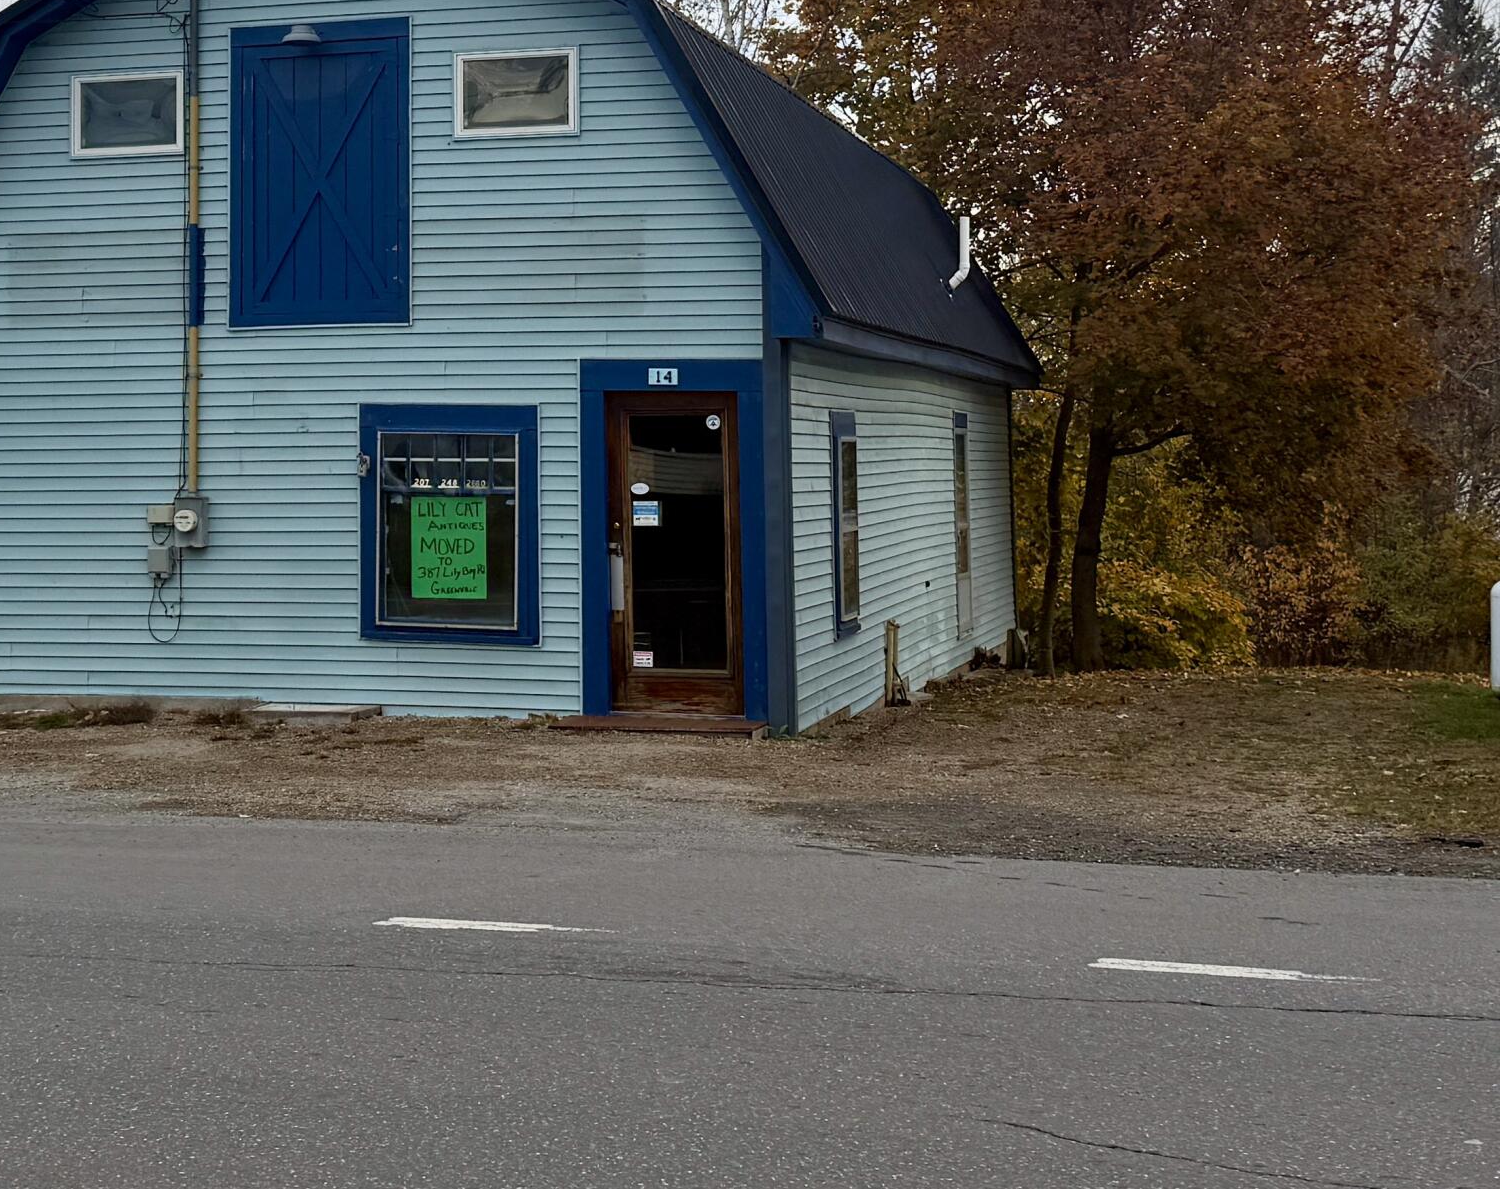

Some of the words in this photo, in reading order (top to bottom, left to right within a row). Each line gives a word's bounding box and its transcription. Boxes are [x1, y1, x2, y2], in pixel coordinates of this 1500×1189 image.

[656, 371, 672, 383] 14
[413, 478, 430, 487] 207
[418, 502, 446, 518] LILY
[456, 501, 483, 518] CAT
[427, 520, 484, 531] ANTIQUES
[420, 536, 475, 555] MOVED
[438, 556, 452, 566] TO
[418, 566, 440, 579] 387
